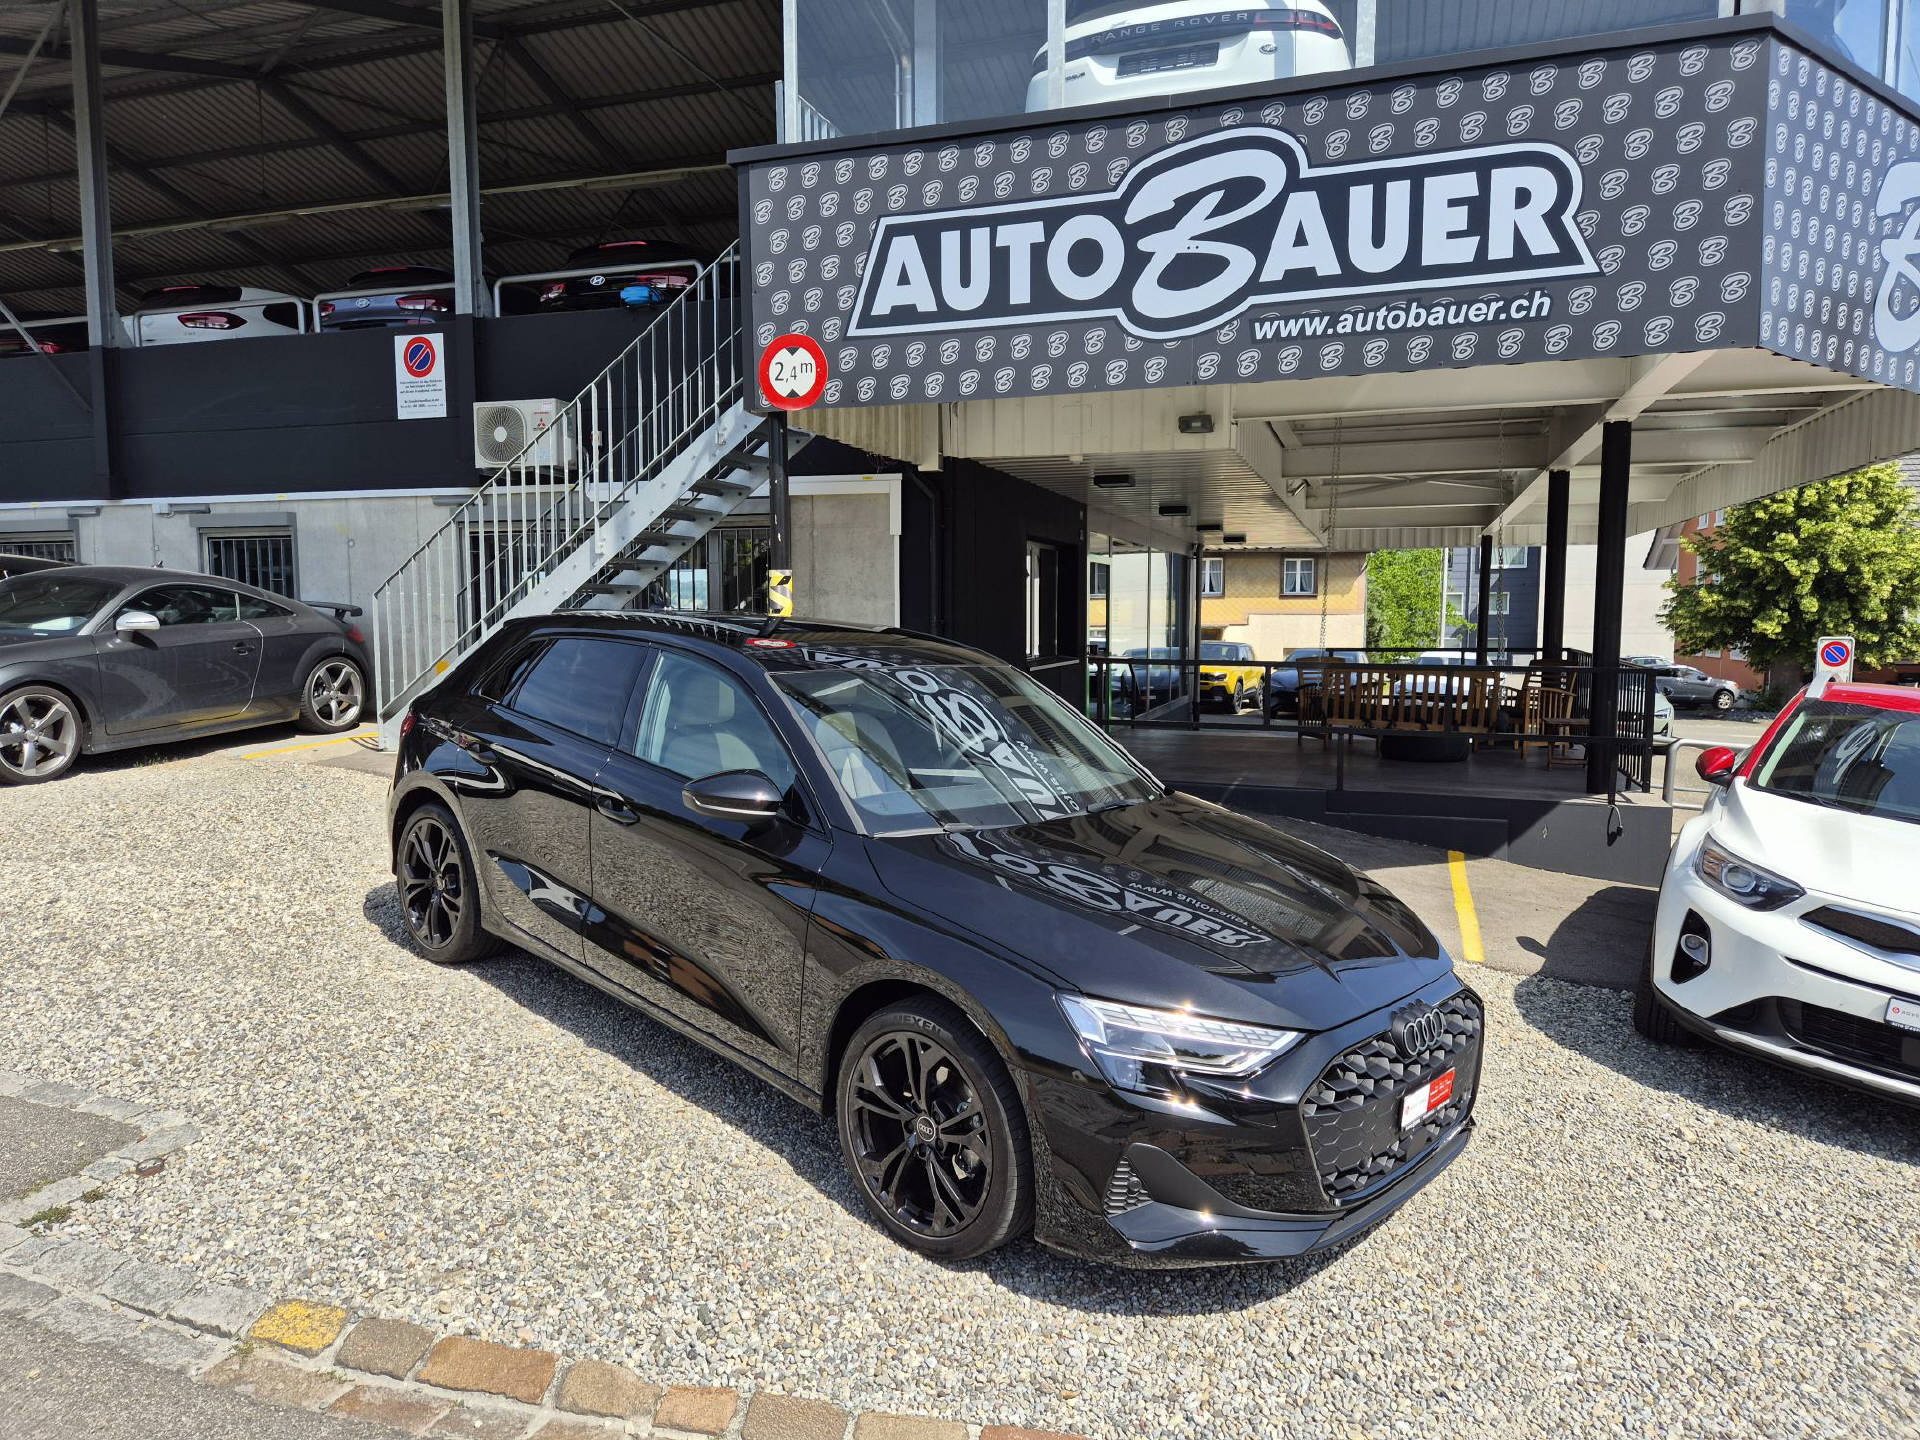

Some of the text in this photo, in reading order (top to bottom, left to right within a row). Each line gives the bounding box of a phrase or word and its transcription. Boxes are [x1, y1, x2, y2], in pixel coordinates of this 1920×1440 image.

[1092, 13, 1249, 44] RANGE ROVER
[1254, 290, 1551, 340] www.autobauer.ch
